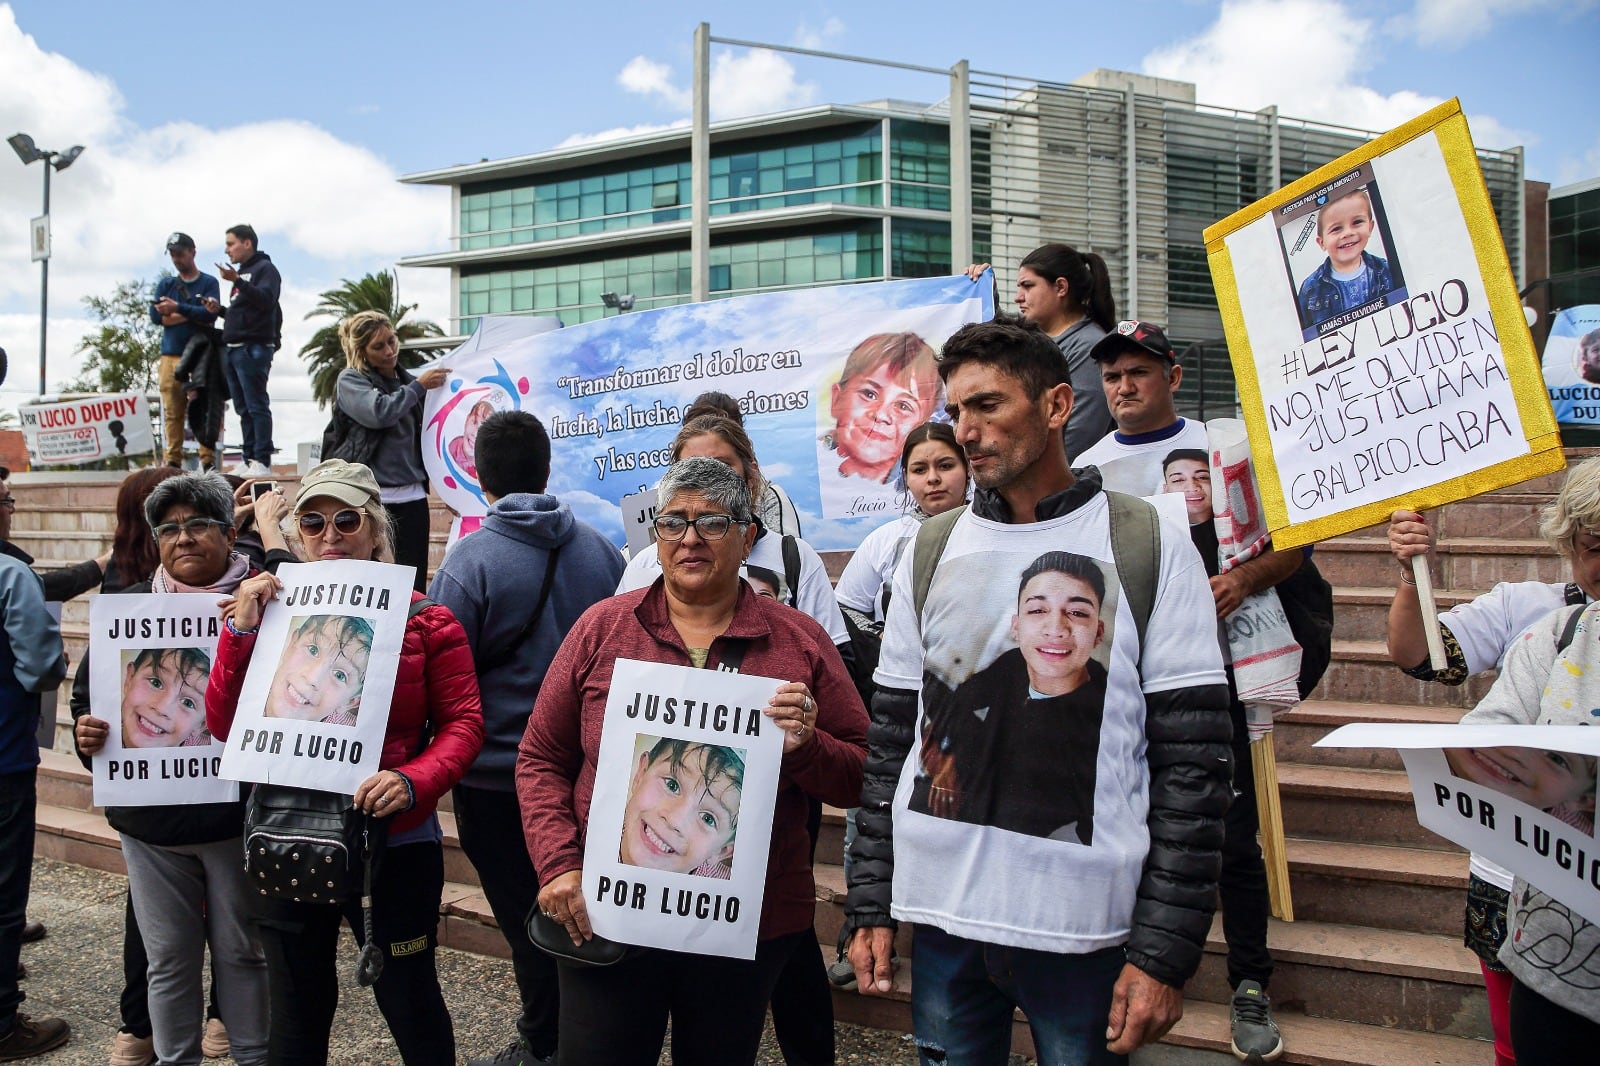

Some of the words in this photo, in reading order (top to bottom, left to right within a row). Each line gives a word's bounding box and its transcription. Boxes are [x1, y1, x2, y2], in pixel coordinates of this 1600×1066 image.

[1342, 311, 1351, 323] TE
[1350, 298, 1385, 320] OLVIDARÉ
[1371, 278, 1469, 347] LUCIO
[683, 353, 704, 380] el
[706, 347, 769, 377] dolor
[771, 349, 802, 369] en
[1315, 366, 1364, 409] ME
[1366, 311, 1500, 390] OLVIDEN
[38, 407, 77, 429] LUCIO
[79, 396, 138, 424] DUPUY
[551, 412, 604, 440] lucha,
[606, 407, 624, 433] la
[625, 399, 681, 430] lucha
[73, 429, 93, 441] 102
[594, 456, 607, 481] y
[608, 446, 636, 473] las
[845, 495, 887, 516] Lucio
[286, 583, 391, 611] JUSTICIA
[108, 616, 219, 640] JUSTICIA
[626, 692, 761, 737] JUSTICIA
[240, 729, 283, 755] POR
[293, 733, 364, 765] LUCIO
[108, 758, 150, 781] POR
[1433, 782, 1496, 831] POR
[596, 876, 647, 910] POR
[660, 887, 741, 924] LUCIO
